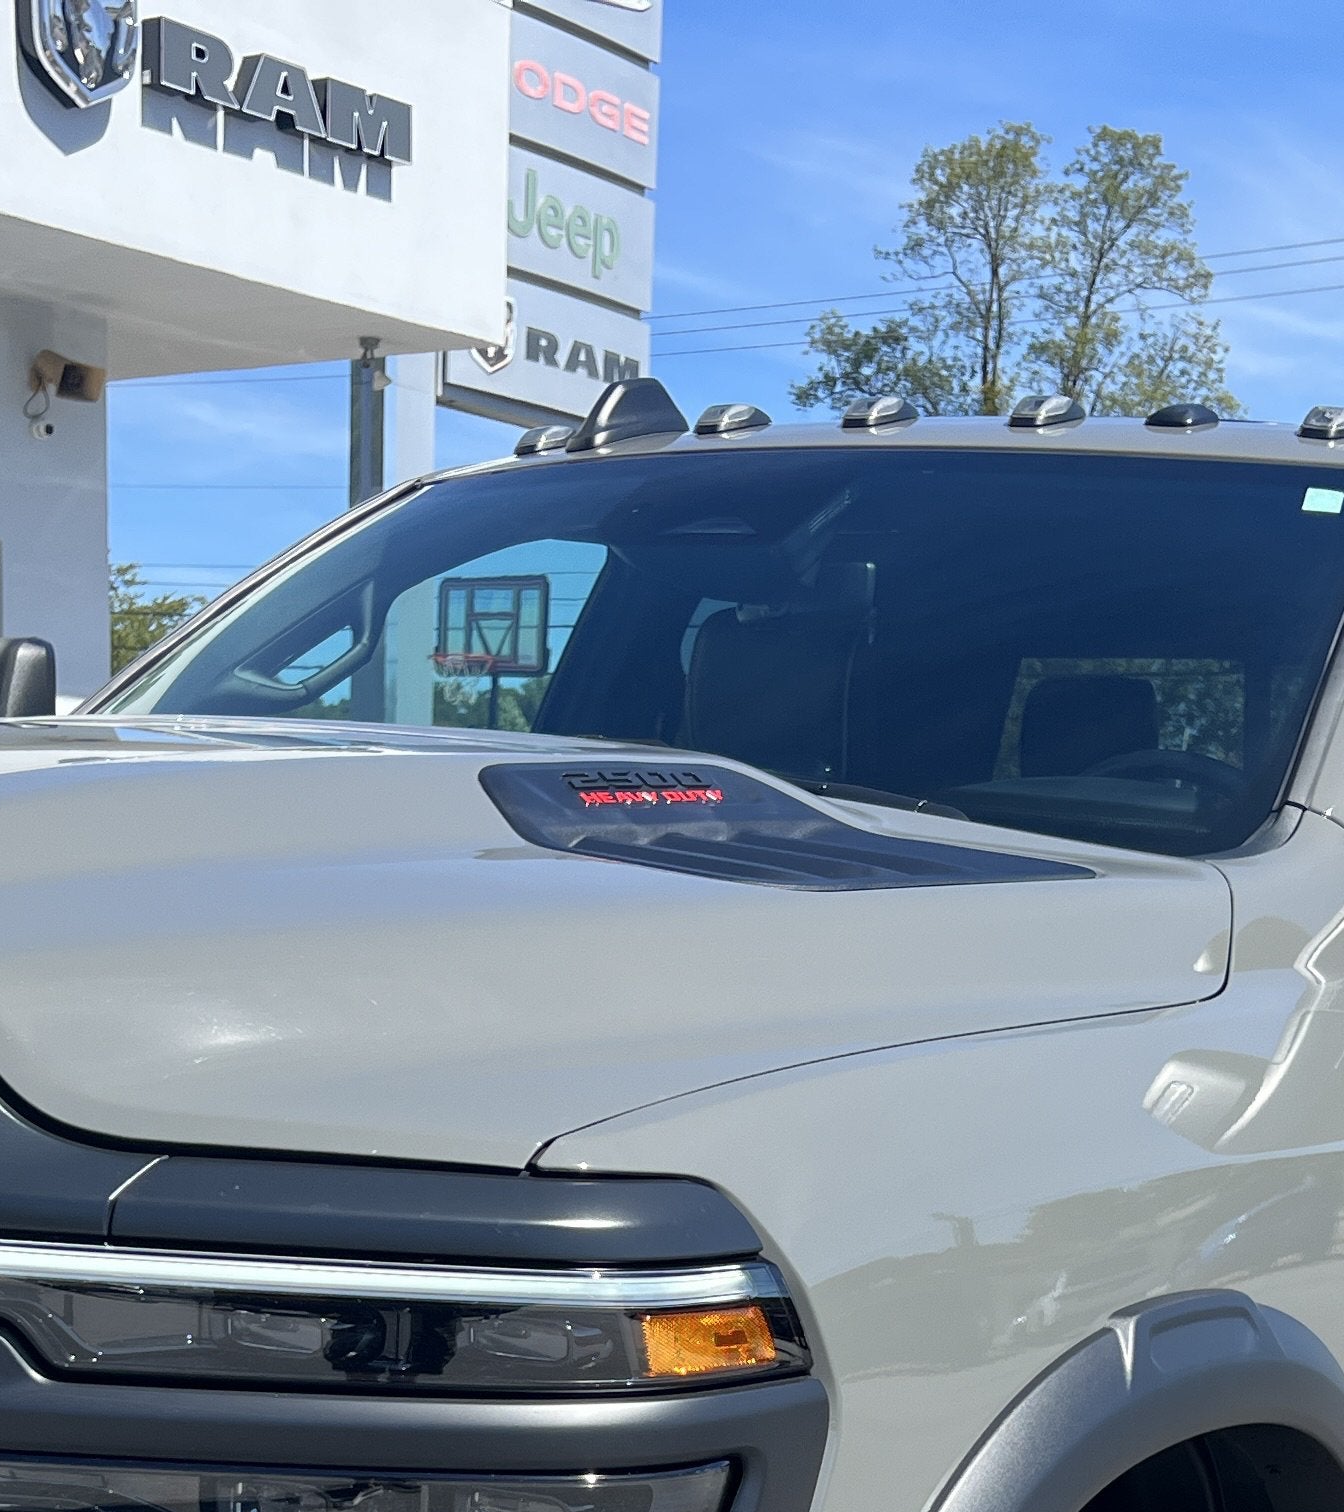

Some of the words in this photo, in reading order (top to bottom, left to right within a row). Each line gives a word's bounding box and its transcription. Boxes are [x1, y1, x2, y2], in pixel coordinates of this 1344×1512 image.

[143, 16, 413, 166] RAM
[507, 168, 622, 280] Jeep
[526, 326, 641, 384] RAM
[562, 771, 716, 791] 2500
[579, 790, 659, 806] HEAVY
[660, 790, 724, 804] DUTY
